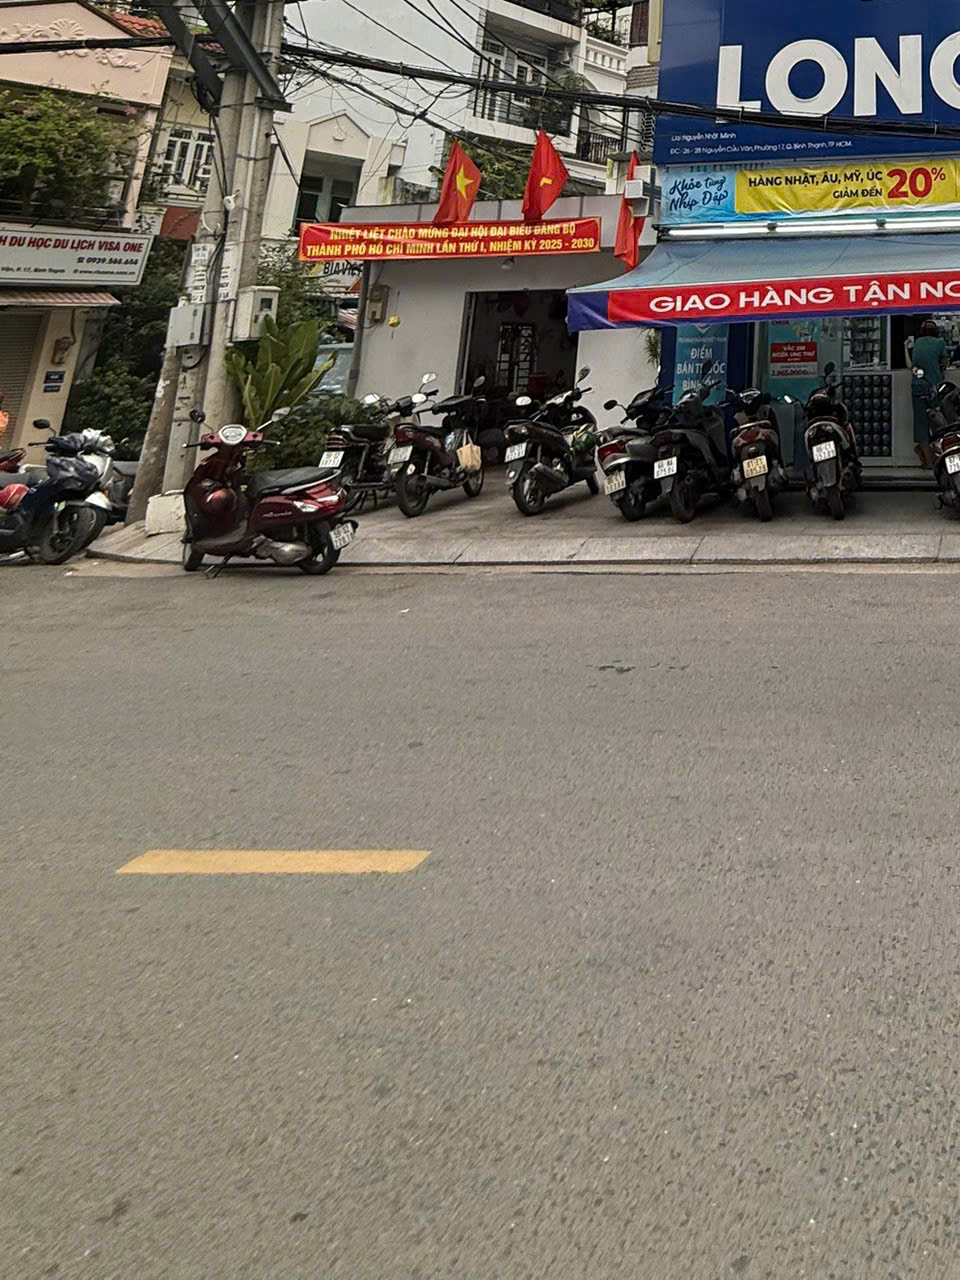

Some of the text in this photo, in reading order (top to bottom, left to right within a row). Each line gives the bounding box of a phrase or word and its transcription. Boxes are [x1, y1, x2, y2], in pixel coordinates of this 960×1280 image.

[748, 166, 946, 199] HÀNG NHẬT, ÂU, MỸ, ÚC 20%
[833, 185, 883, 200] GIẢM ĐẾN
[329, 222, 576, 241] NHIỆT LIỆT CHÀO MỪNG ĐẠI HỘI ĐẠI BIỂU ĐẢNG BỘ
[9, 236, 26, 247] DU
[28, 237, 52, 250] HỌC
[53, 239, 71, 249] DU
[71, 239, 96, 252] LỊCH
[98, 241, 121, 251] VISA
[123, 242, 144, 253] ONE
[306, 242, 342, 257] THÀNH
[344, 240, 367, 256] PHỐ
[368, 241, 384, 255] HỒ
[386, 241, 404, 255] CHÍ
[406, 242, 434, 254] MINH
[436, 240, 457, 254] LẦN
[460, 240, 480, 253] THỨ
[490, 239, 522, 254] NHIỆM
[524, 237, 538, 250] KỲ
[539, 238, 563, 250] 2025
[571, 237, 595, 249] 2030
[649, 293, 731, 314] GIAO
[738, 284, 834, 309] HÀNG
[843, 280, 911, 307] TẬN
[691, 345, 713, 360] ĐIỂM
[677, 361, 694, 375] BÁN
